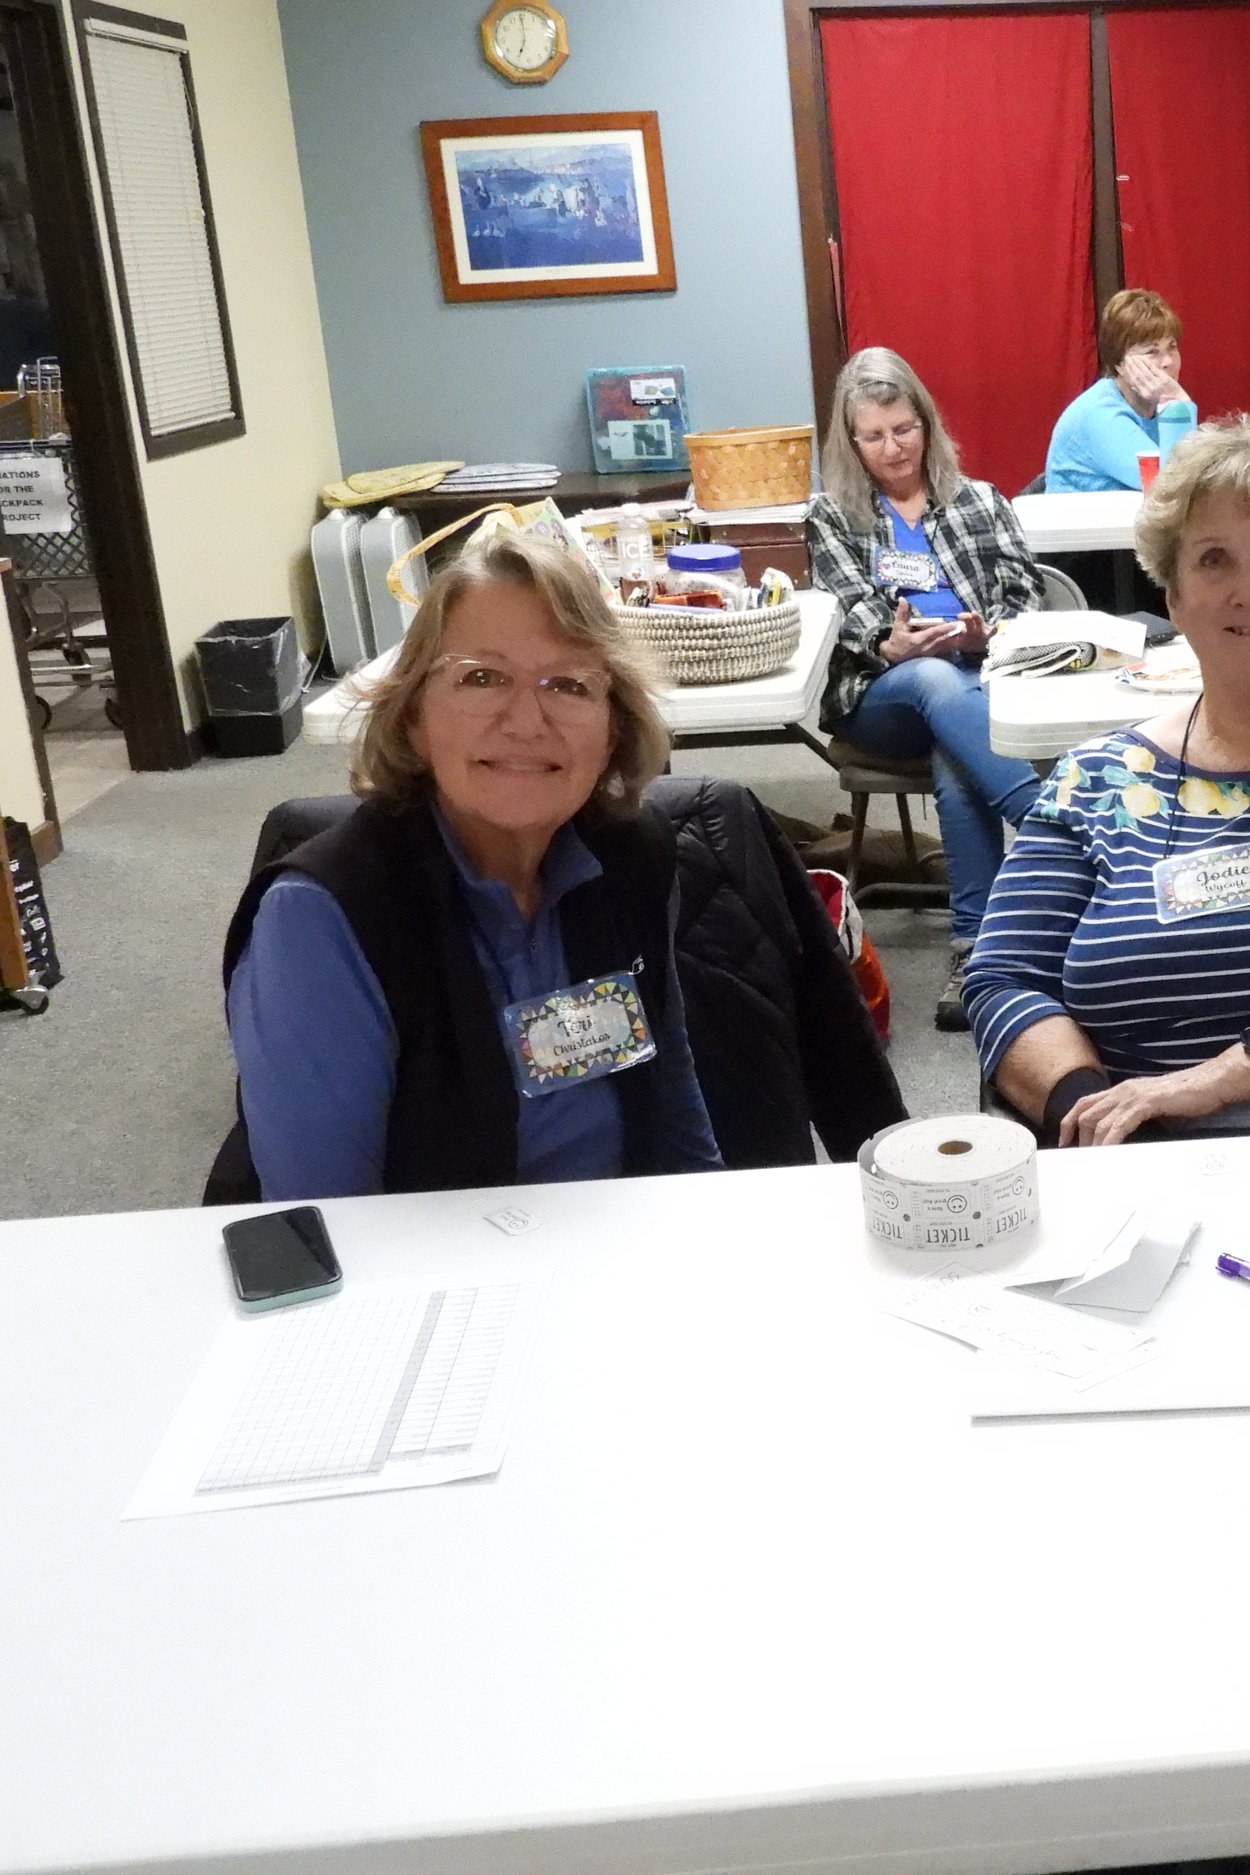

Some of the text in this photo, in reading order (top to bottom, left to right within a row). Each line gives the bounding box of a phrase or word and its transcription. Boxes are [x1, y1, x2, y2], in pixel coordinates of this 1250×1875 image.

[0, 471, 40, 479] ATIONS
[13, 485, 34, 493] THE
[622, 540, 651, 559] ICE
[872, 1215, 902, 1240] TICKET
[994, 1207, 1028, 1234] TICKET
[926, 1226, 971, 1243] TICKET
